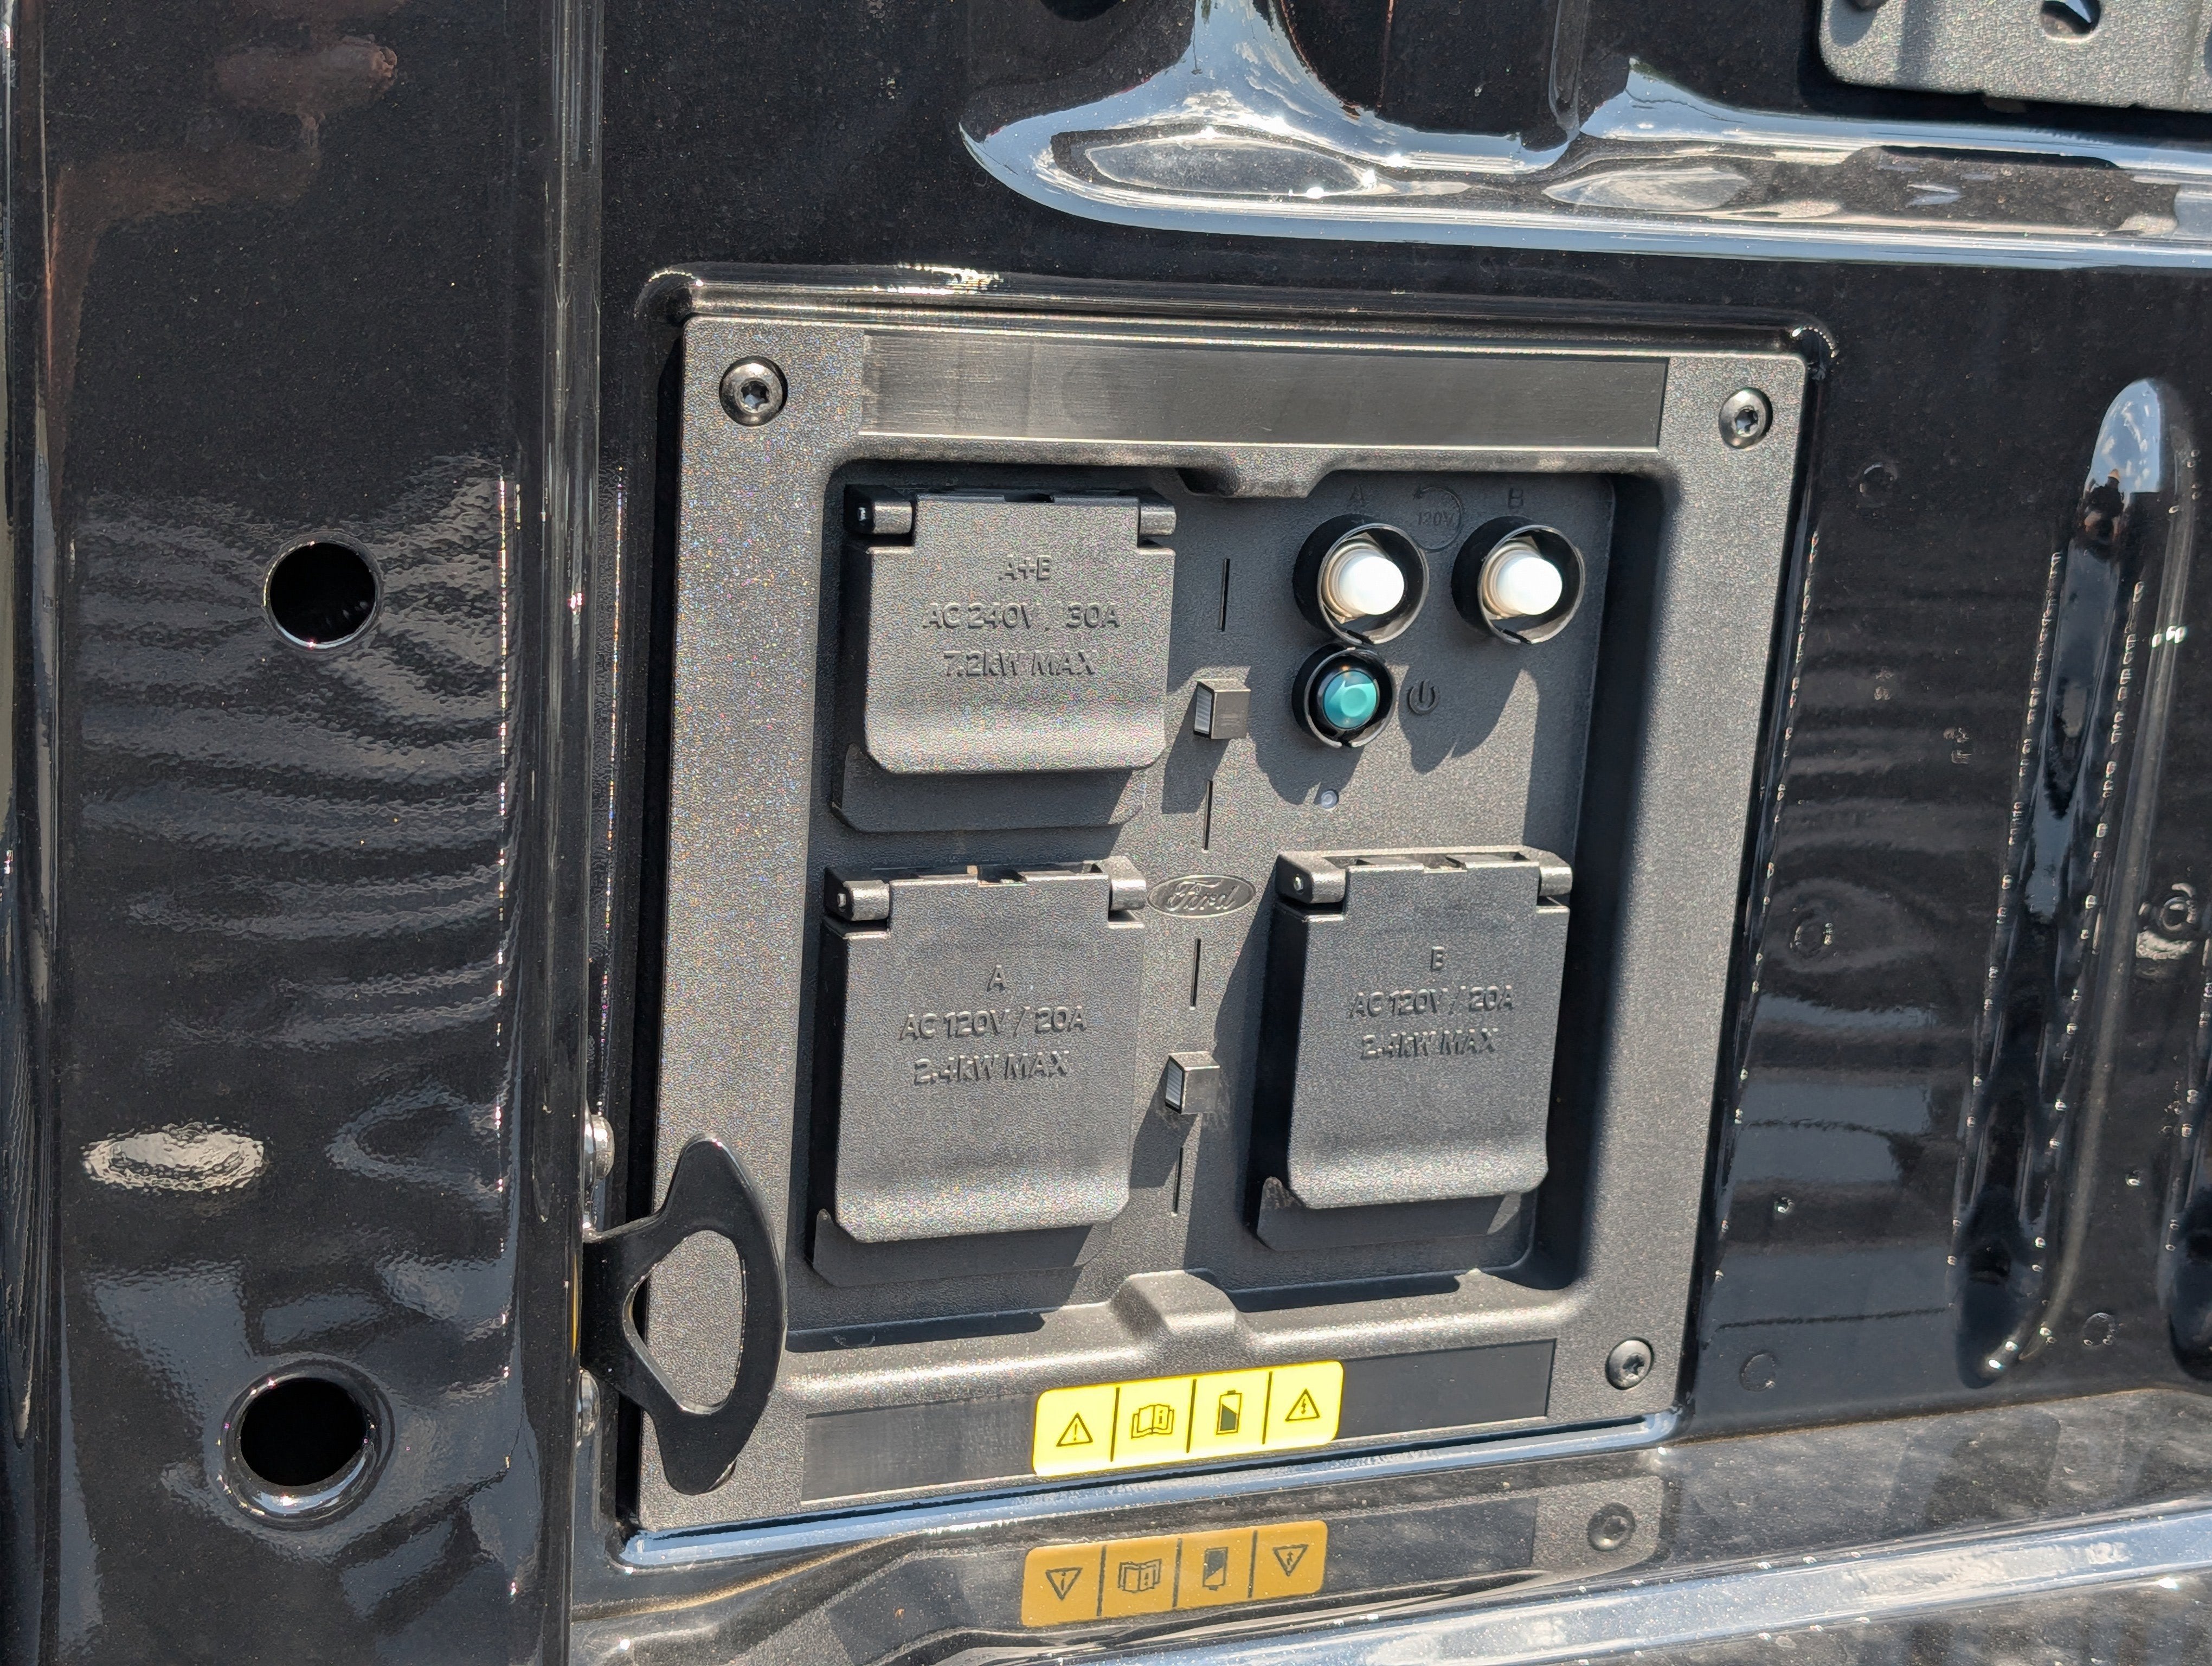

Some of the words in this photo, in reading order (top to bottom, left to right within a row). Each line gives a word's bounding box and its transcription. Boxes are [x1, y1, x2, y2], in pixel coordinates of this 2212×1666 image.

[1066, 601, 1120, 628] 30A
[1031, 649, 1096, 676] MAX
[1166, 879, 1240, 912] Ford
[987, 964, 1006, 992] A
[1469, 984, 1514, 1012] 20A
[1034, 1005, 1088, 1034] 20A
[1440, 1028, 1499, 1055] MAX
[1005, 1050, 1070, 1079] MAX
